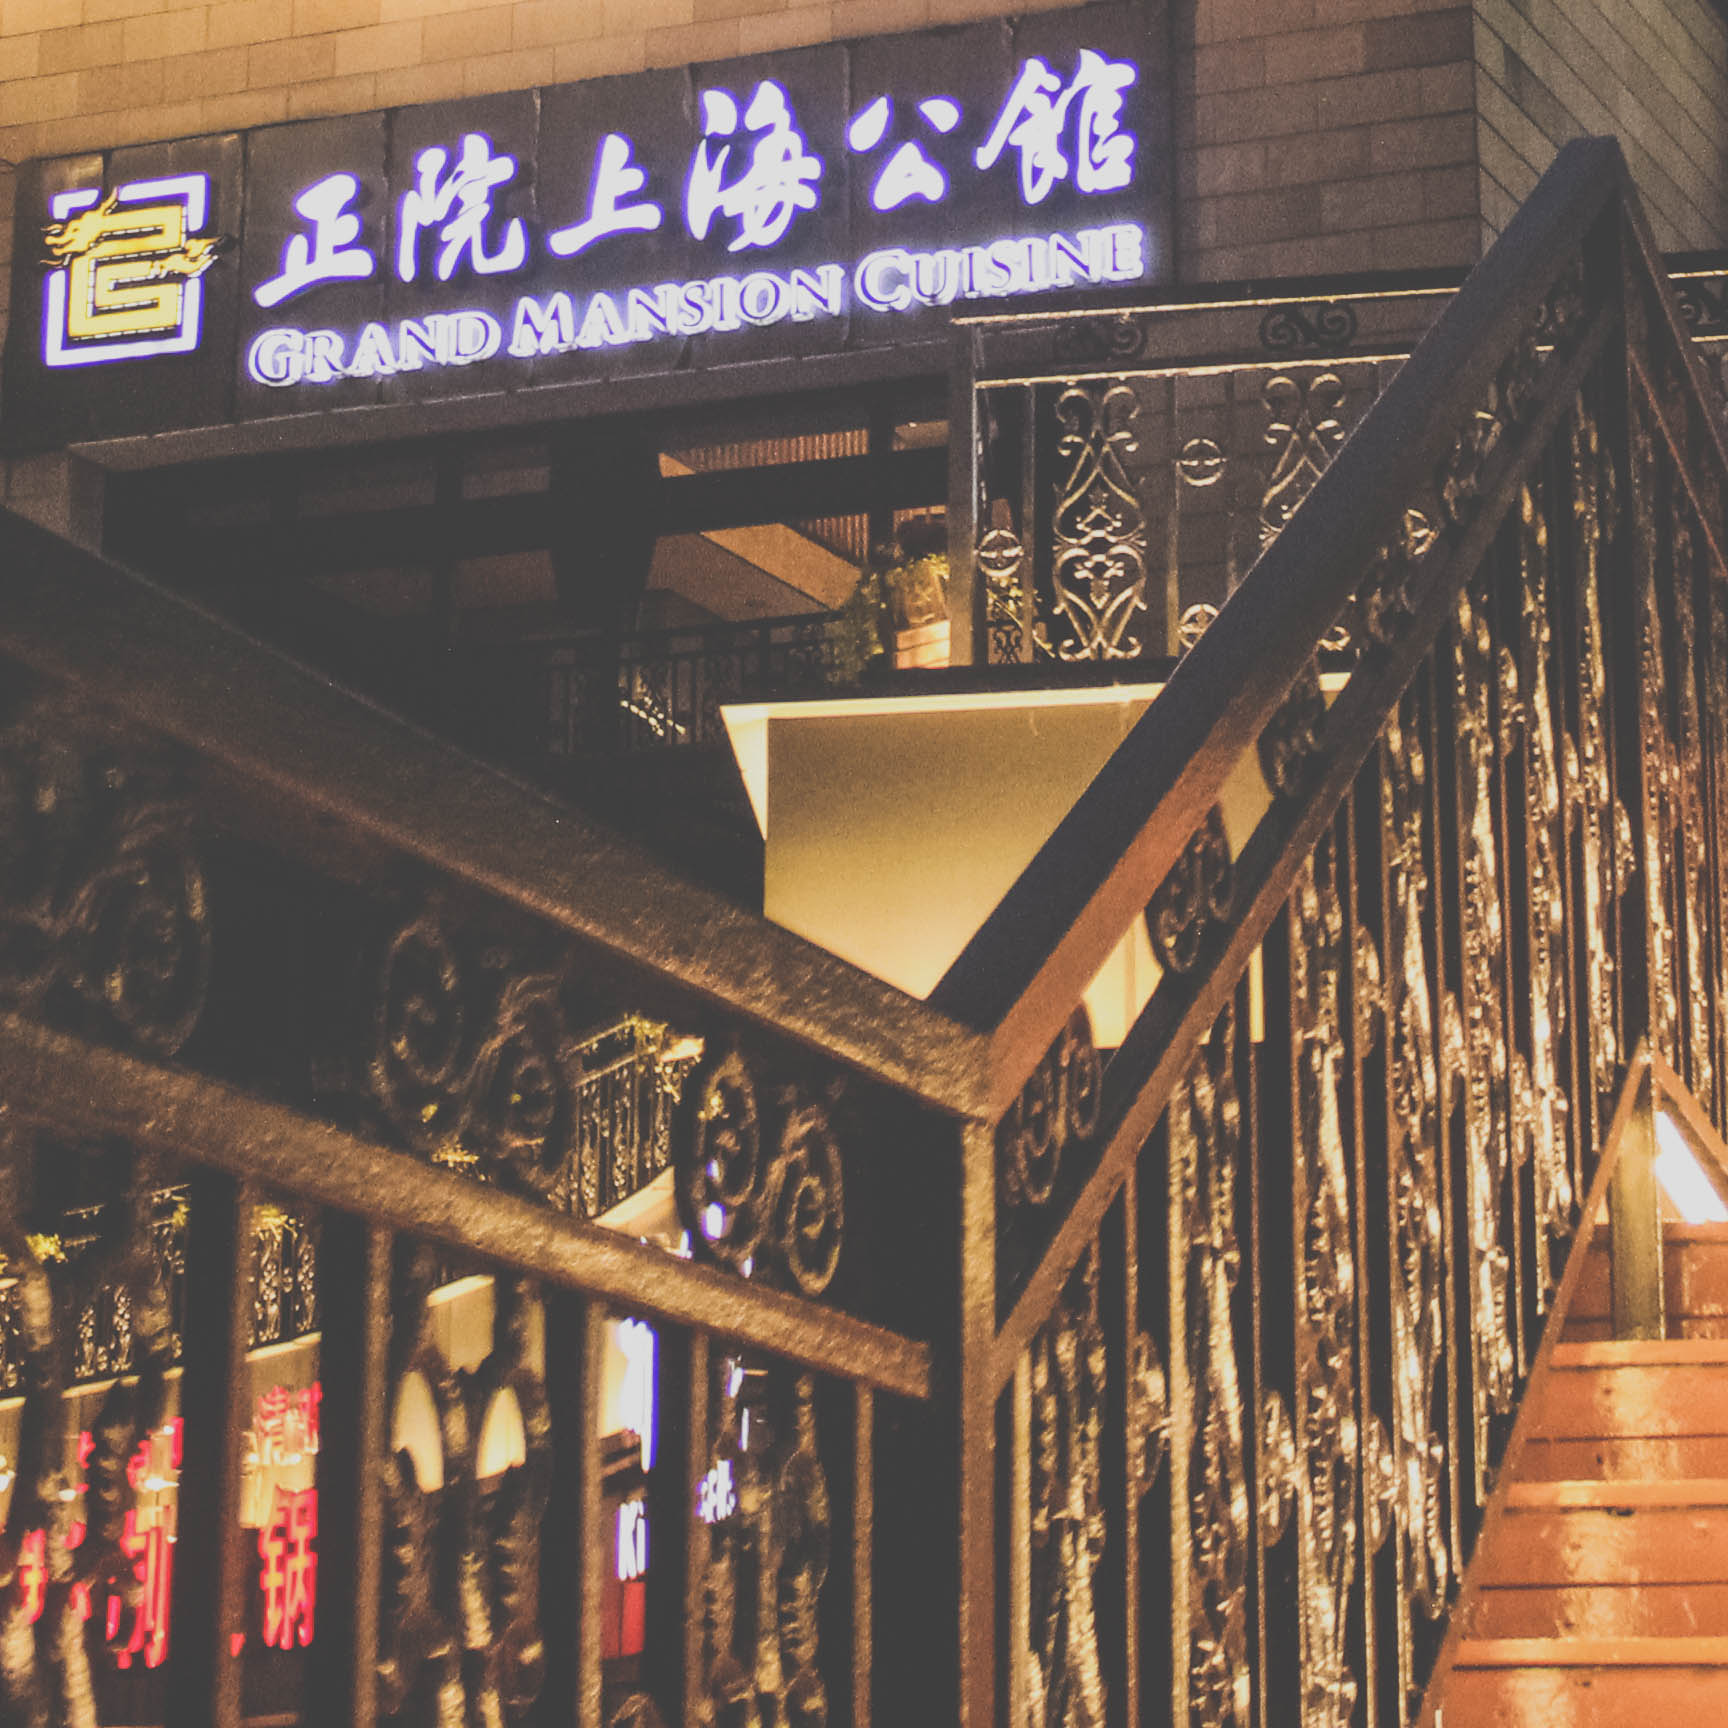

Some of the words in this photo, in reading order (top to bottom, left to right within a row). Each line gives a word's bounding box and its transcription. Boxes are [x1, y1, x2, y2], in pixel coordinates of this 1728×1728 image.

[251, 46, 1138, 309] 正院上海公館
[246, 310, 503, 387] GRAND
[506, 262, 847, 359] MANSION
[853, 222, 1145, 312] CUISINE
